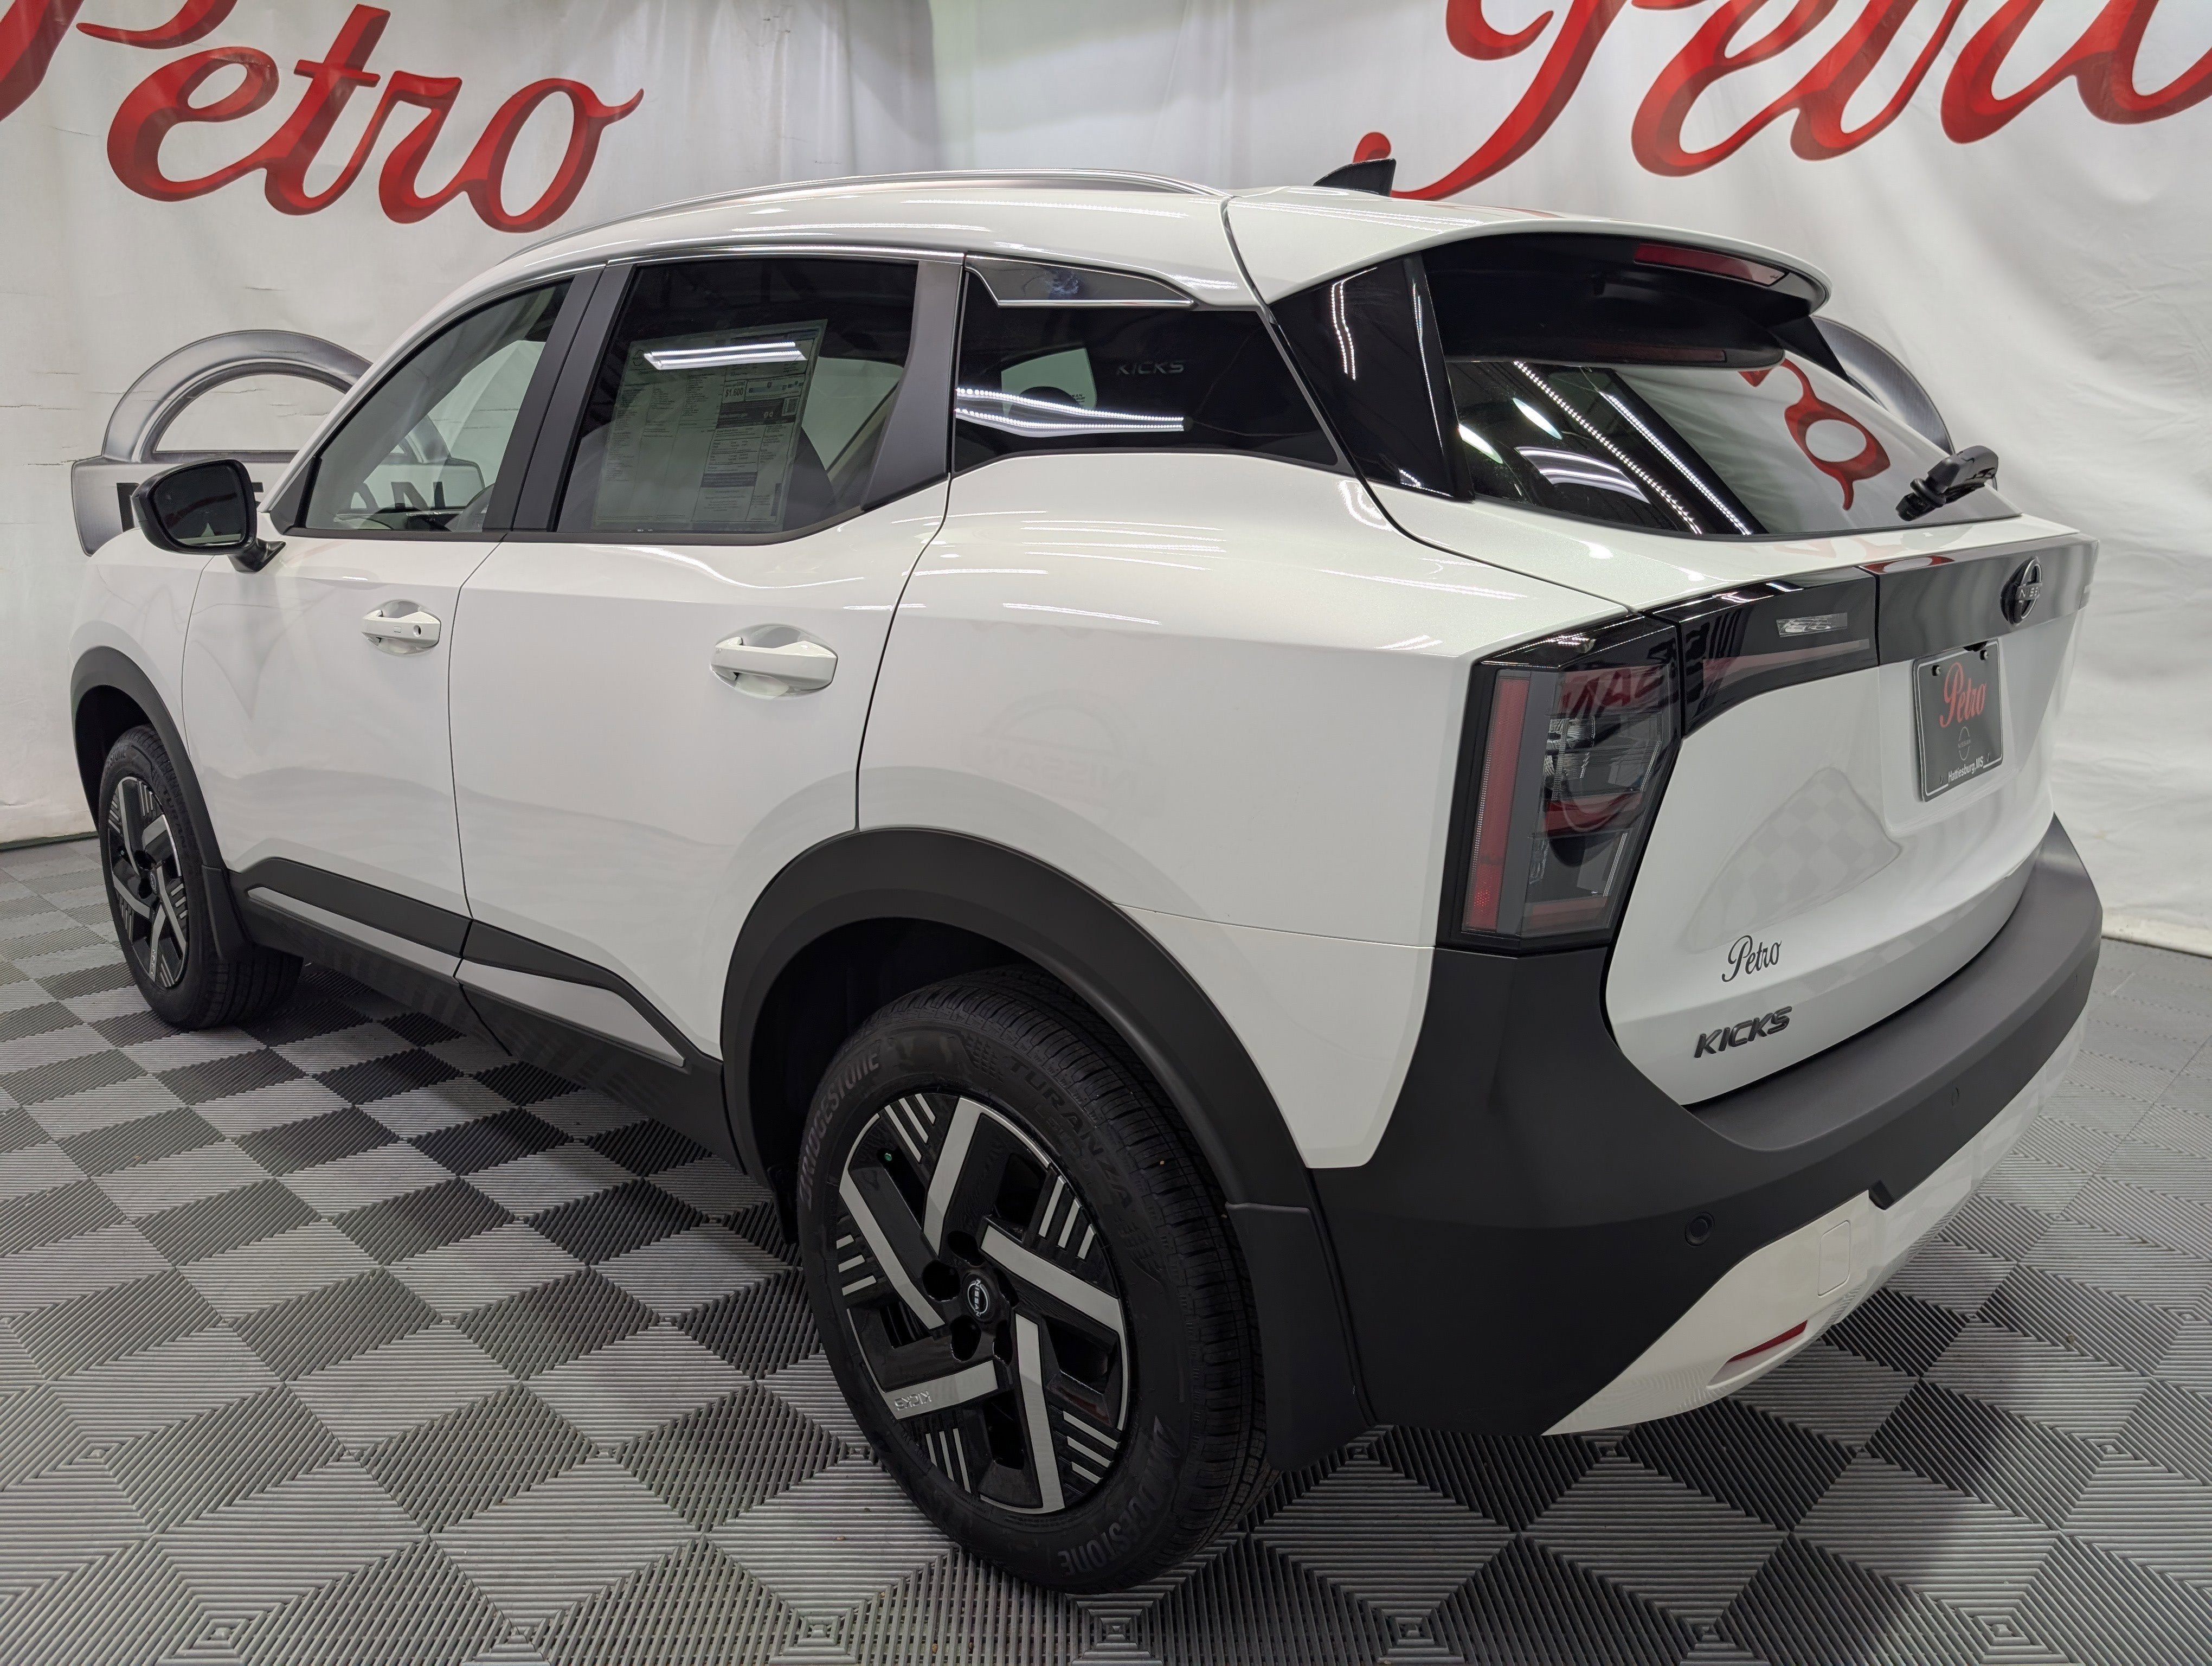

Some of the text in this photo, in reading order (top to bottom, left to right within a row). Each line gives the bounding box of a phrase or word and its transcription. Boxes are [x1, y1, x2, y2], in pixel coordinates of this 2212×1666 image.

[1116, 360, 1185, 375] KICKS
[2018, 586, 2040, 598] NSS
[1939, 662, 1987, 728] Petro
[1721, 935, 1782, 983] Petro
[1694, 1006, 1792, 1059] KICKS
[894, 1390, 933, 1411] KICKS
